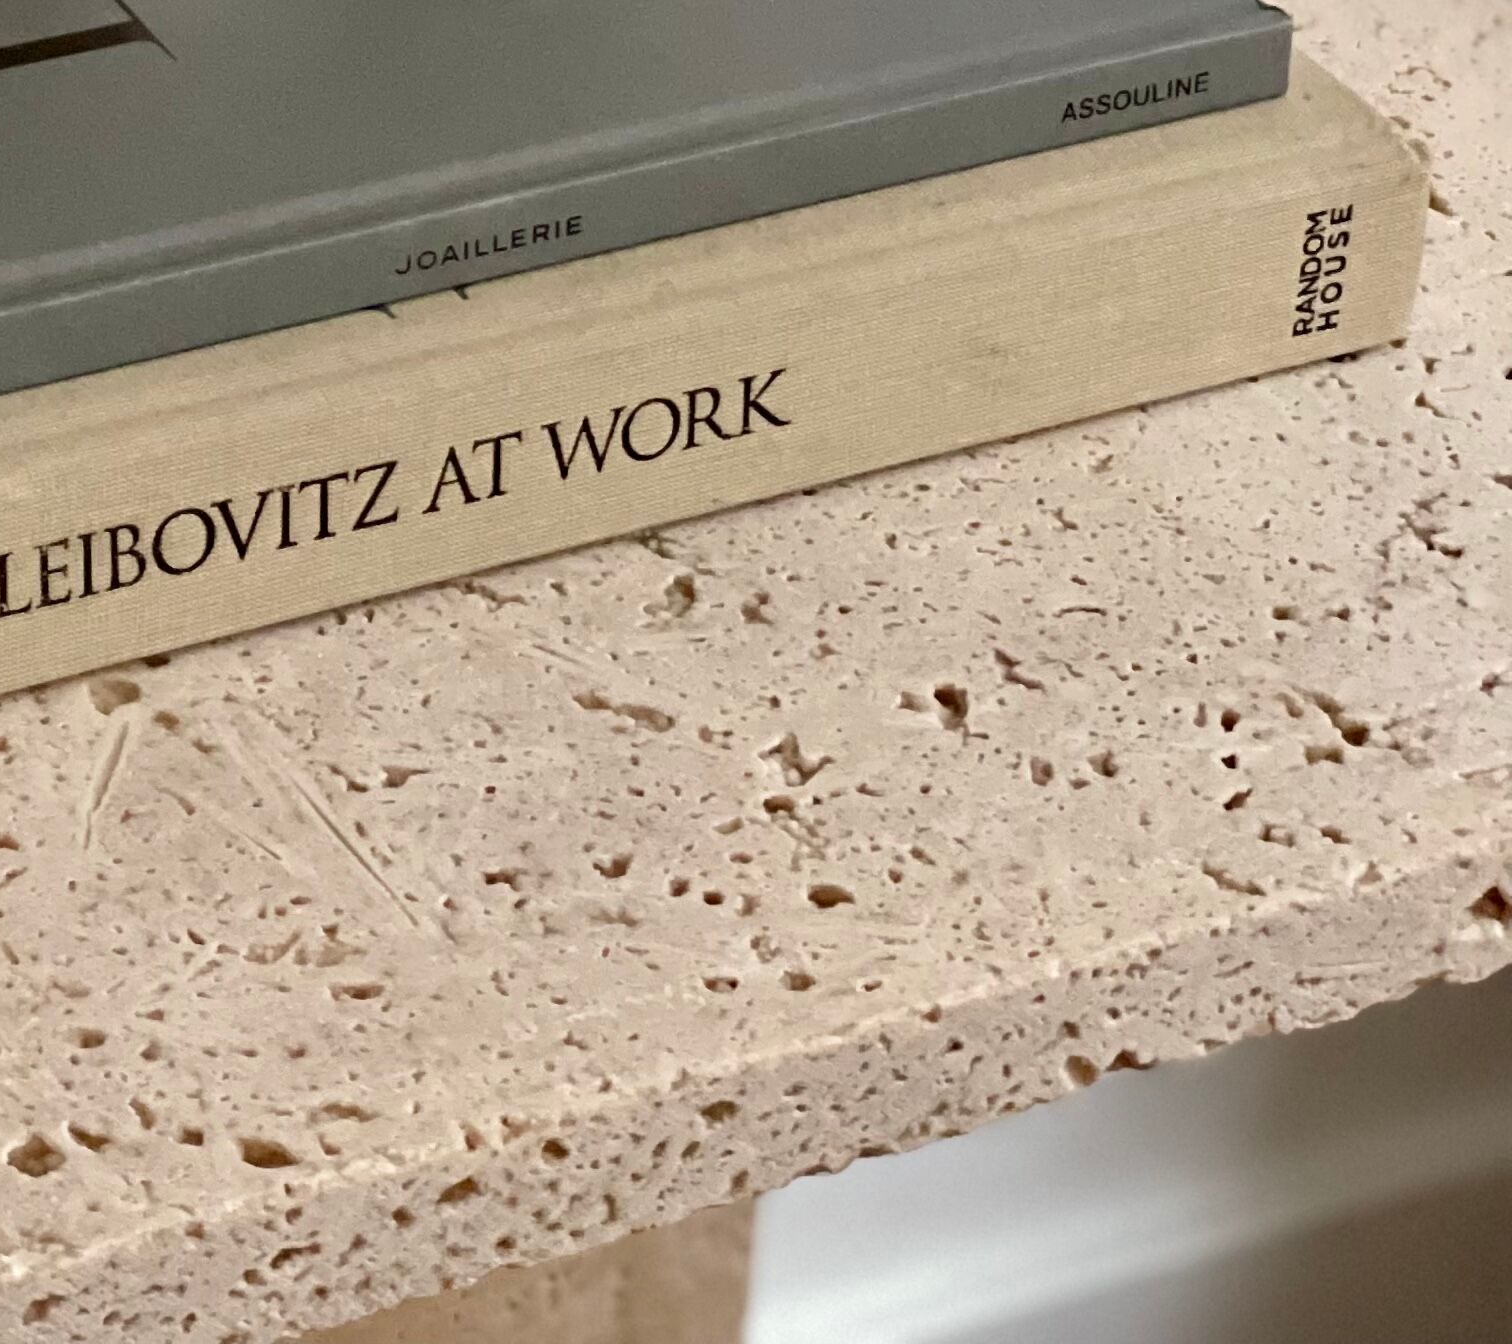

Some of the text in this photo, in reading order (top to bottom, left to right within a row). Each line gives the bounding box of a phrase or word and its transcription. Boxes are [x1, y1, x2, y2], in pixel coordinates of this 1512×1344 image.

[1061, 71, 1210, 123] ASSOULINE
[395, 215, 584, 275] JOAILLERIE
[1292, 210, 1329, 337] RANDOM
[1316, 204, 1354, 332] HOUSE
[422, 431, 523, 514] AT
[541, 368, 791, 482] WORK
